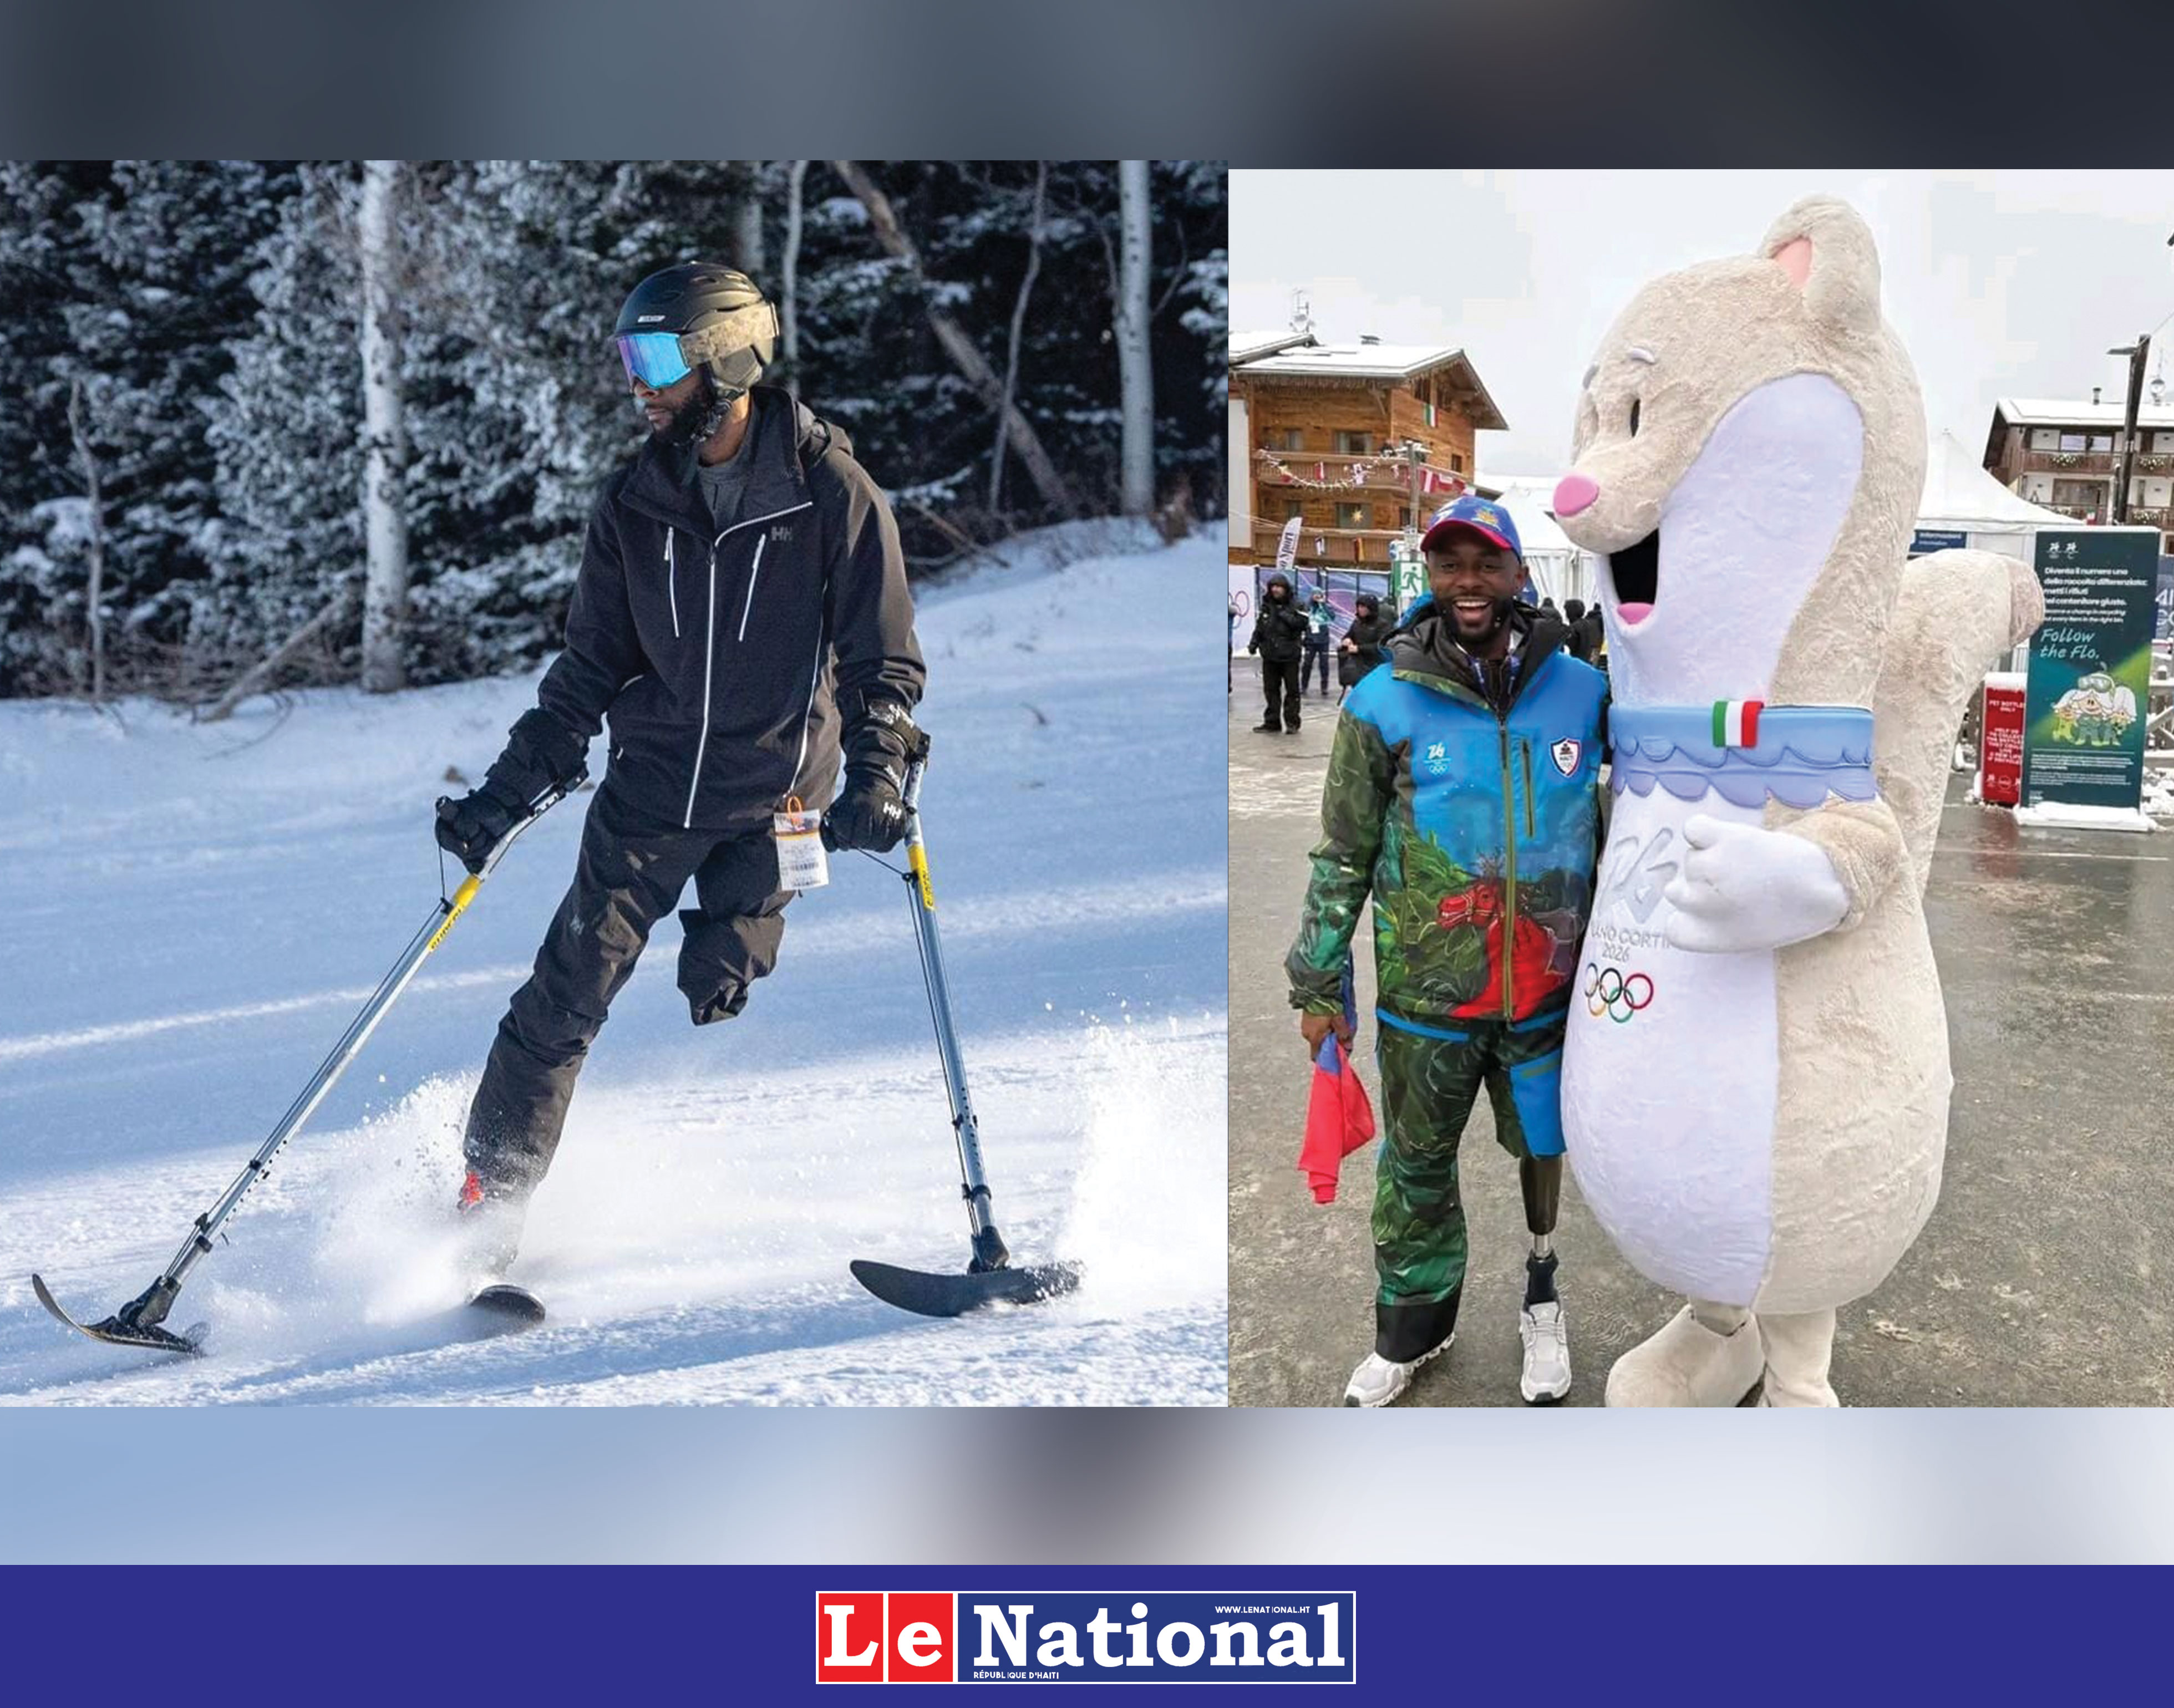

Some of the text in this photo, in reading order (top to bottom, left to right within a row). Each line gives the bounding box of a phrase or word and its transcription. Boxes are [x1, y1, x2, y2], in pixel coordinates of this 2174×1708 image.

[2040, 627, 2095, 642] Follow
[2040, 644, 2067, 658] the
[883, 802, 902, 820] HH
[1602, 942, 1631, 963] 2026
